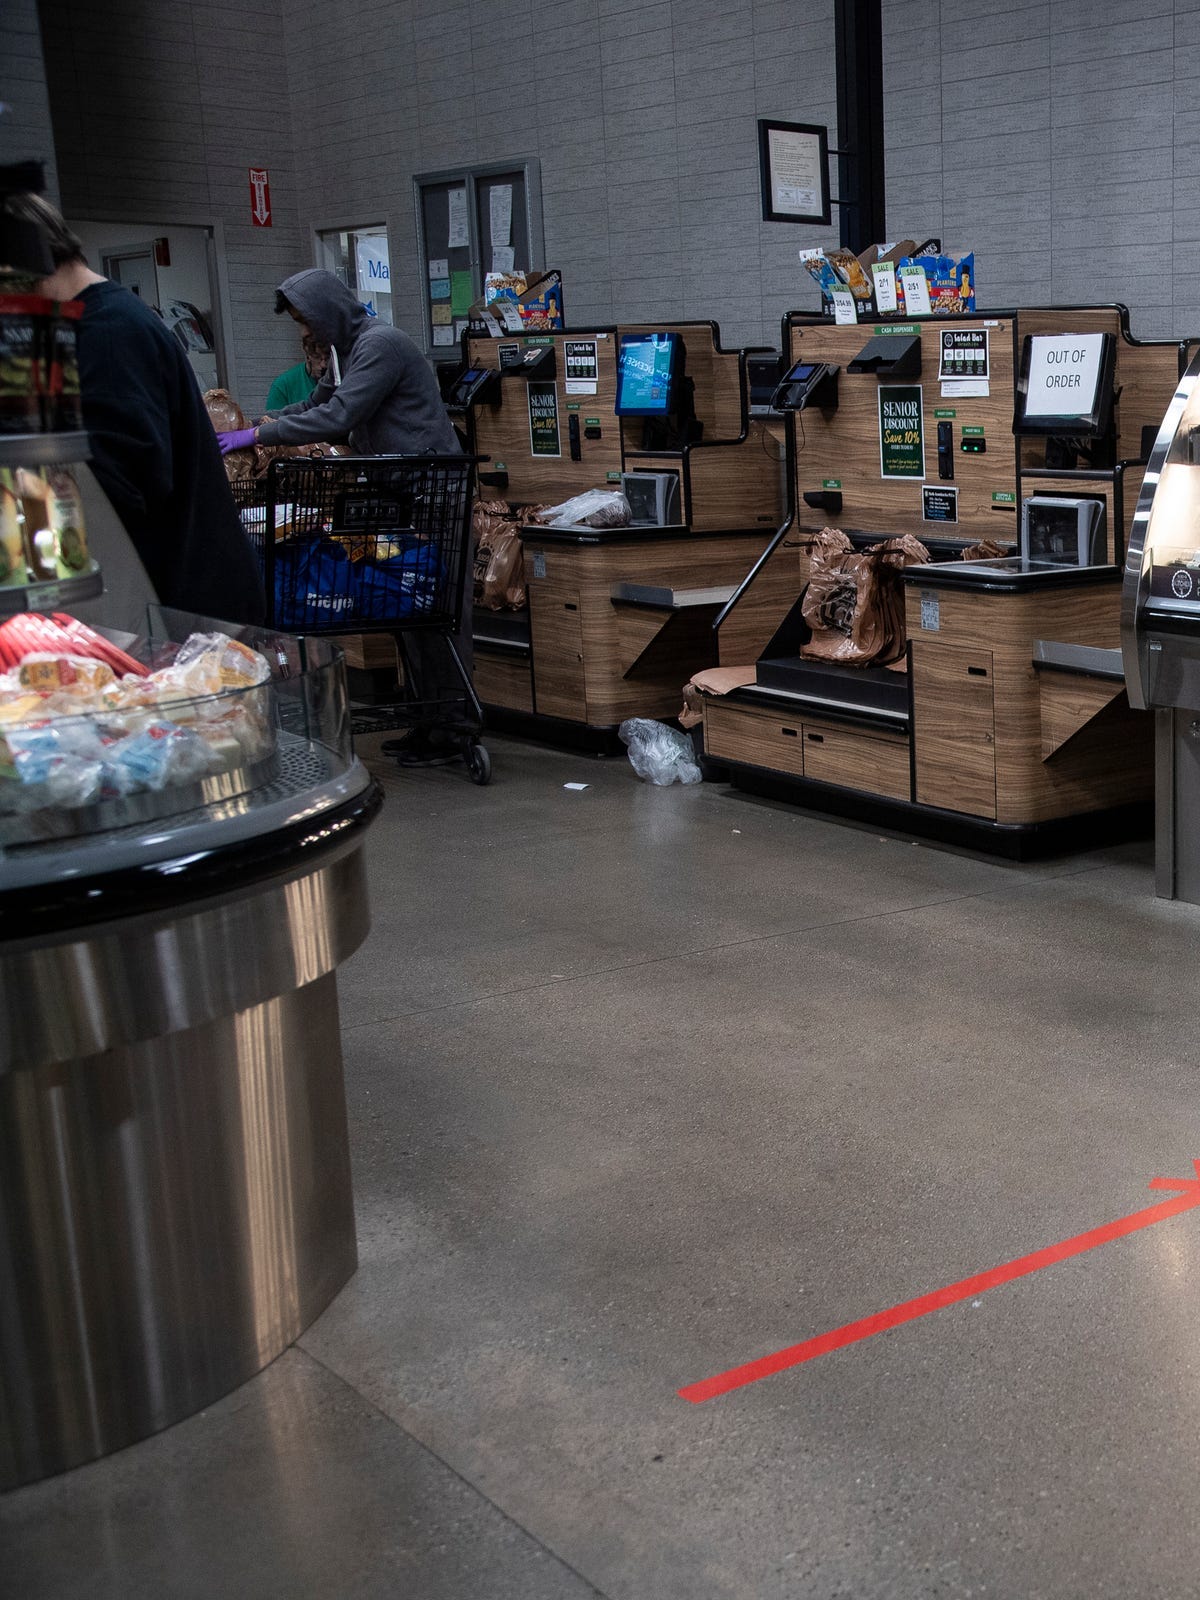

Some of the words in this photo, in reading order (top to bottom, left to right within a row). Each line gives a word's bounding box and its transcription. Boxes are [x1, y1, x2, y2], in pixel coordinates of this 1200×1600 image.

[252, 174, 265, 182] FIRE
[368, 260, 390, 279] Ma
[877, 264, 889, 272] SALE
[906, 268, 920, 276] SALE
[954, 333, 971, 342] Salad
[971, 333, 983, 342] Bar
[1047, 350, 1069, 364] OUT
[1071, 349, 1086, 363] OF
[1046, 374, 1081, 388] ORDER
[531, 394, 555, 407] SENIOR
[531, 407, 556, 417] DISCOUNT
[883, 401, 919, 417] SENIOR
[532, 417, 545, 429] Save
[545, 418, 557, 429] 10%
[884, 418, 919, 431] DISCOUNT
[884, 430, 902, 444] Save
[905, 431, 920, 445] 10%
